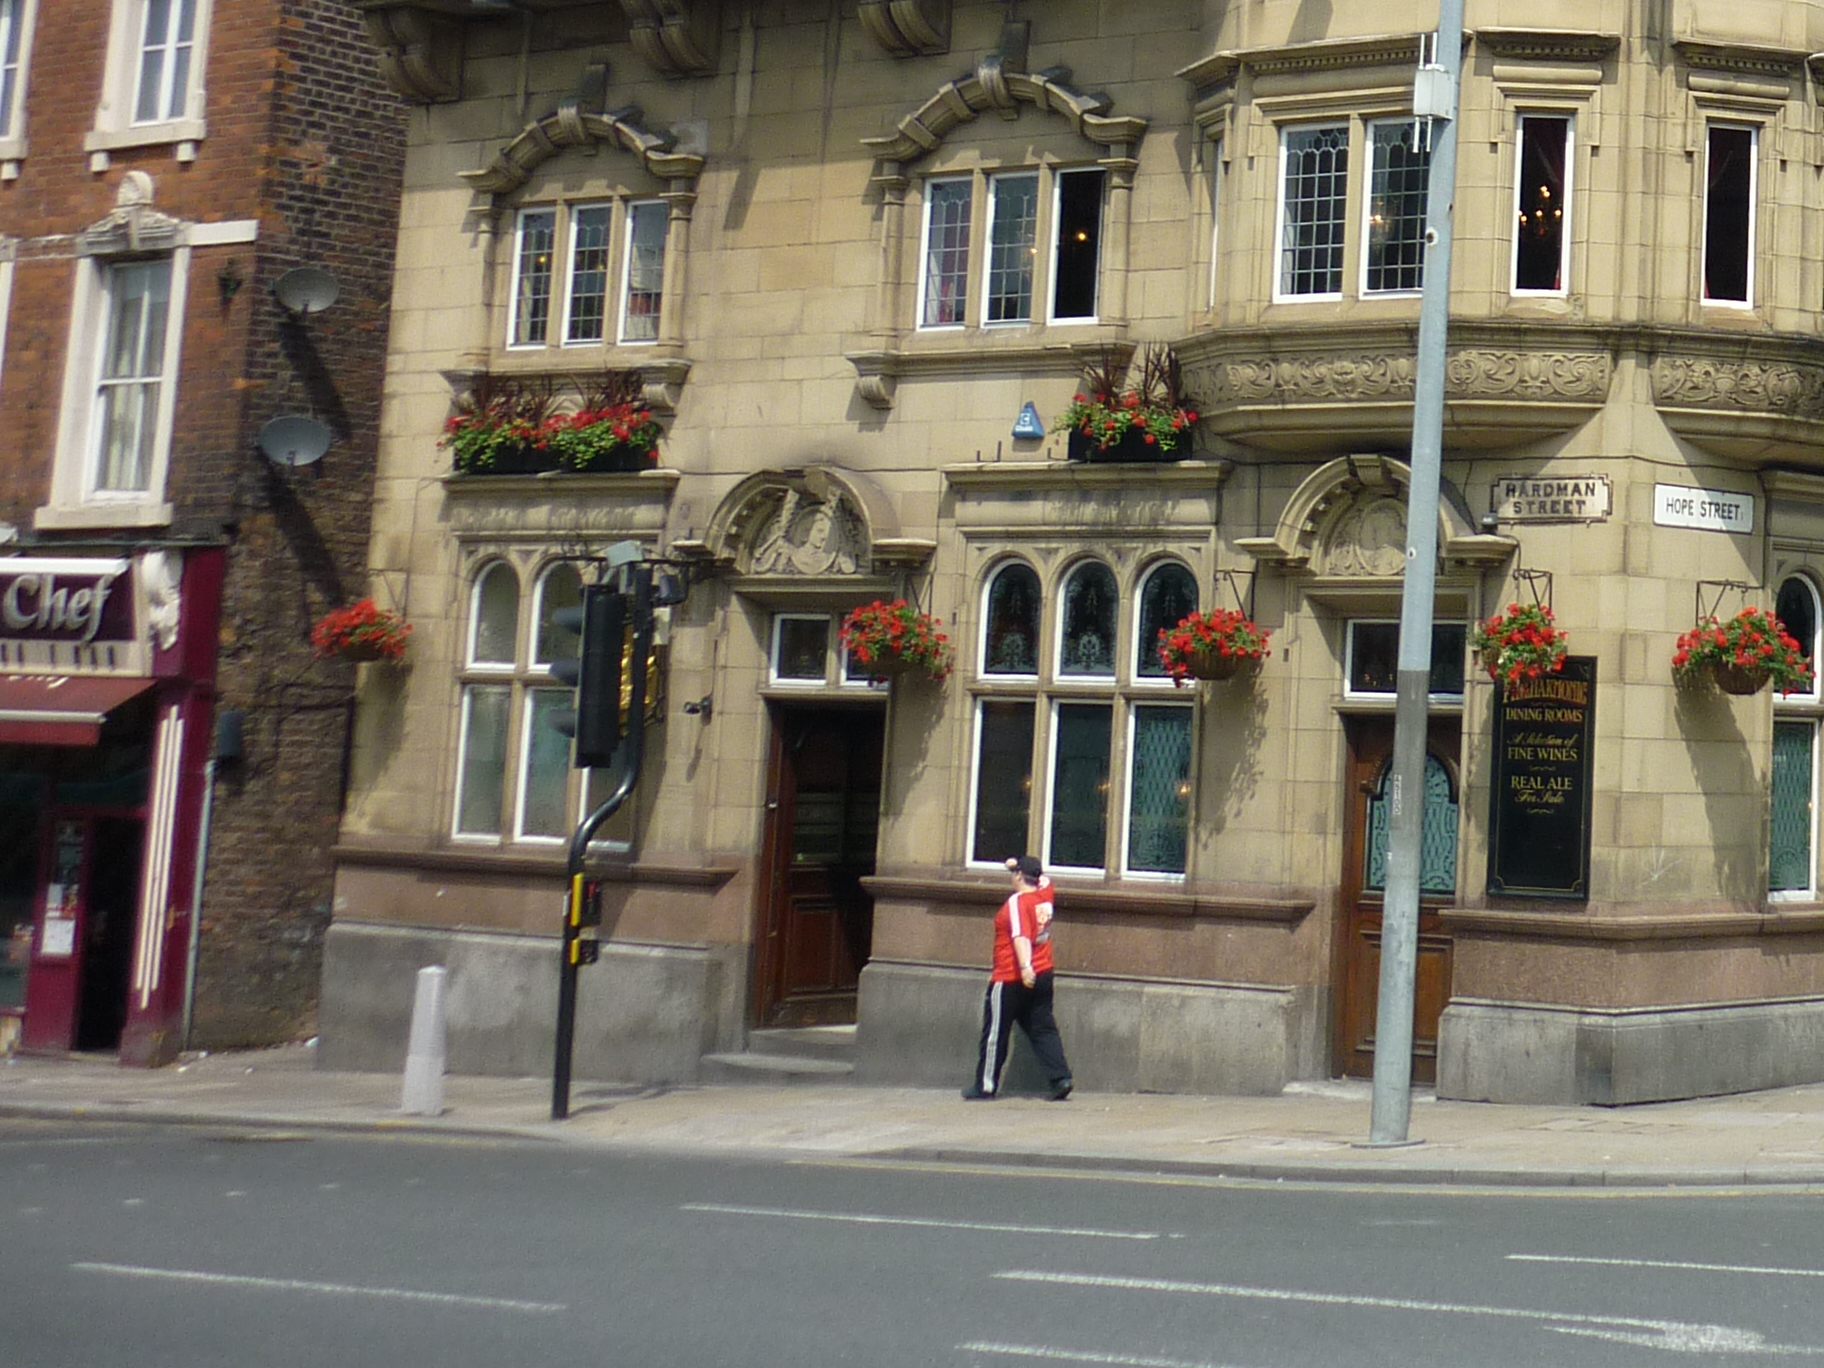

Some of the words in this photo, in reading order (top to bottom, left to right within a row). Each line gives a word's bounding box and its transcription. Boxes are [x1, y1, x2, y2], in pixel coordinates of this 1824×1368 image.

[1505, 482, 1596, 497] HARDMAN
[1513, 499, 1586, 514] STREET
[1666, 496, 1694, 516] HOPE
[1700, 501, 1741, 521] STREET
[2, 573, 114, 643] Chef
[1506, 707, 1542, 721] DINING
[1545, 709, 1582, 722] ROOMS
[1508, 747, 1535, 760] FINE
[1537, 748, 1578, 761] WINES
[1511, 775, 1545, 789] REAL
[1547, 777, 1573, 790] ALE
